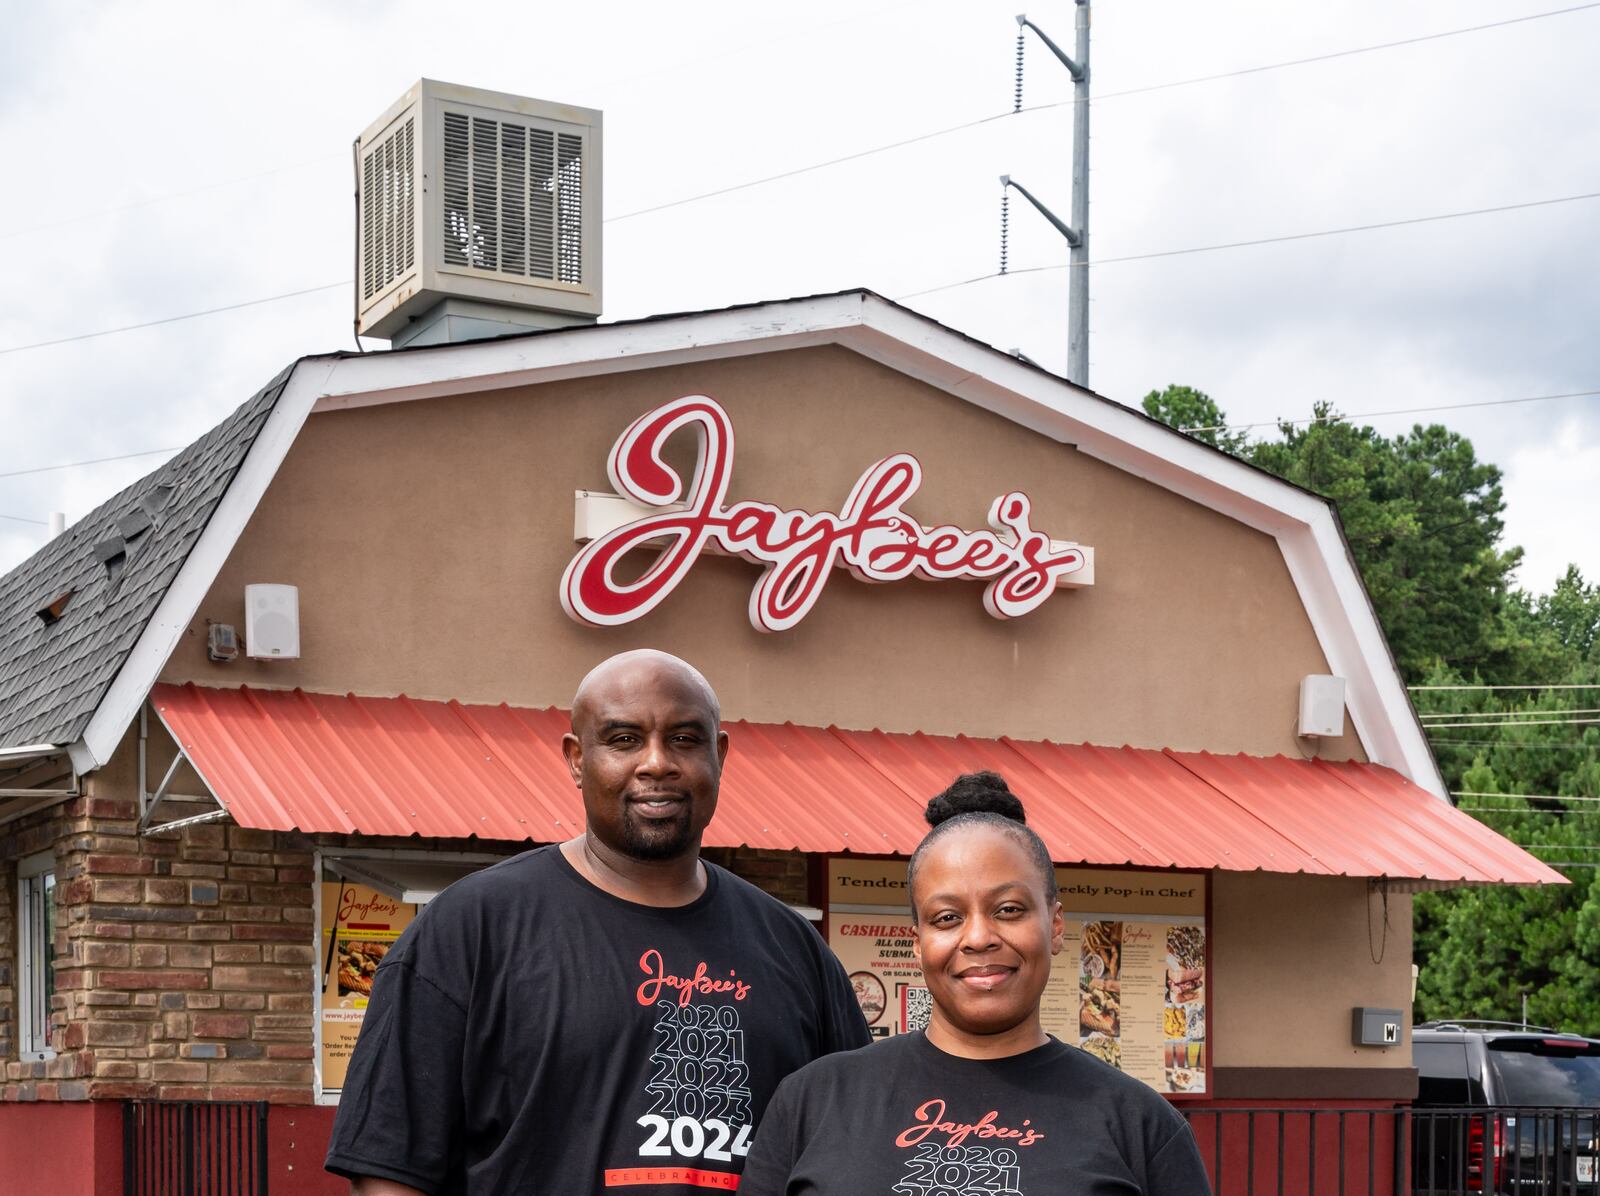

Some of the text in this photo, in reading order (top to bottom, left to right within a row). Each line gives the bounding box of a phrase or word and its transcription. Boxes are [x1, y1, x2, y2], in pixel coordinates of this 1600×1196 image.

[560, 394, 1084, 632] Jaybee's
[339, 888, 399, 921] Jaybee's
[1056, 885, 1099, 897] eekly
[1104, 886, 1154, 898] Pop-in
[1158, 888, 1196, 898] Chef
[875, 939, 892, 947] ALL
[637, 949, 751, 1008] Jaybee's
[657, 1000, 739, 1032] 2020
[654, 1022, 744, 1064] 2021
[650, 1053, 750, 1097] 2022
[645, 1082, 753, 1130] 2023
[896, 1099, 1045, 1148] Jaybee's
[636, 1114, 753, 1162] 2024
[914, 1142, 1017, 1168] 2020
[611, 1171, 730, 1186] CELEBRATING
[901, 1160, 1020, 1193] 2021
